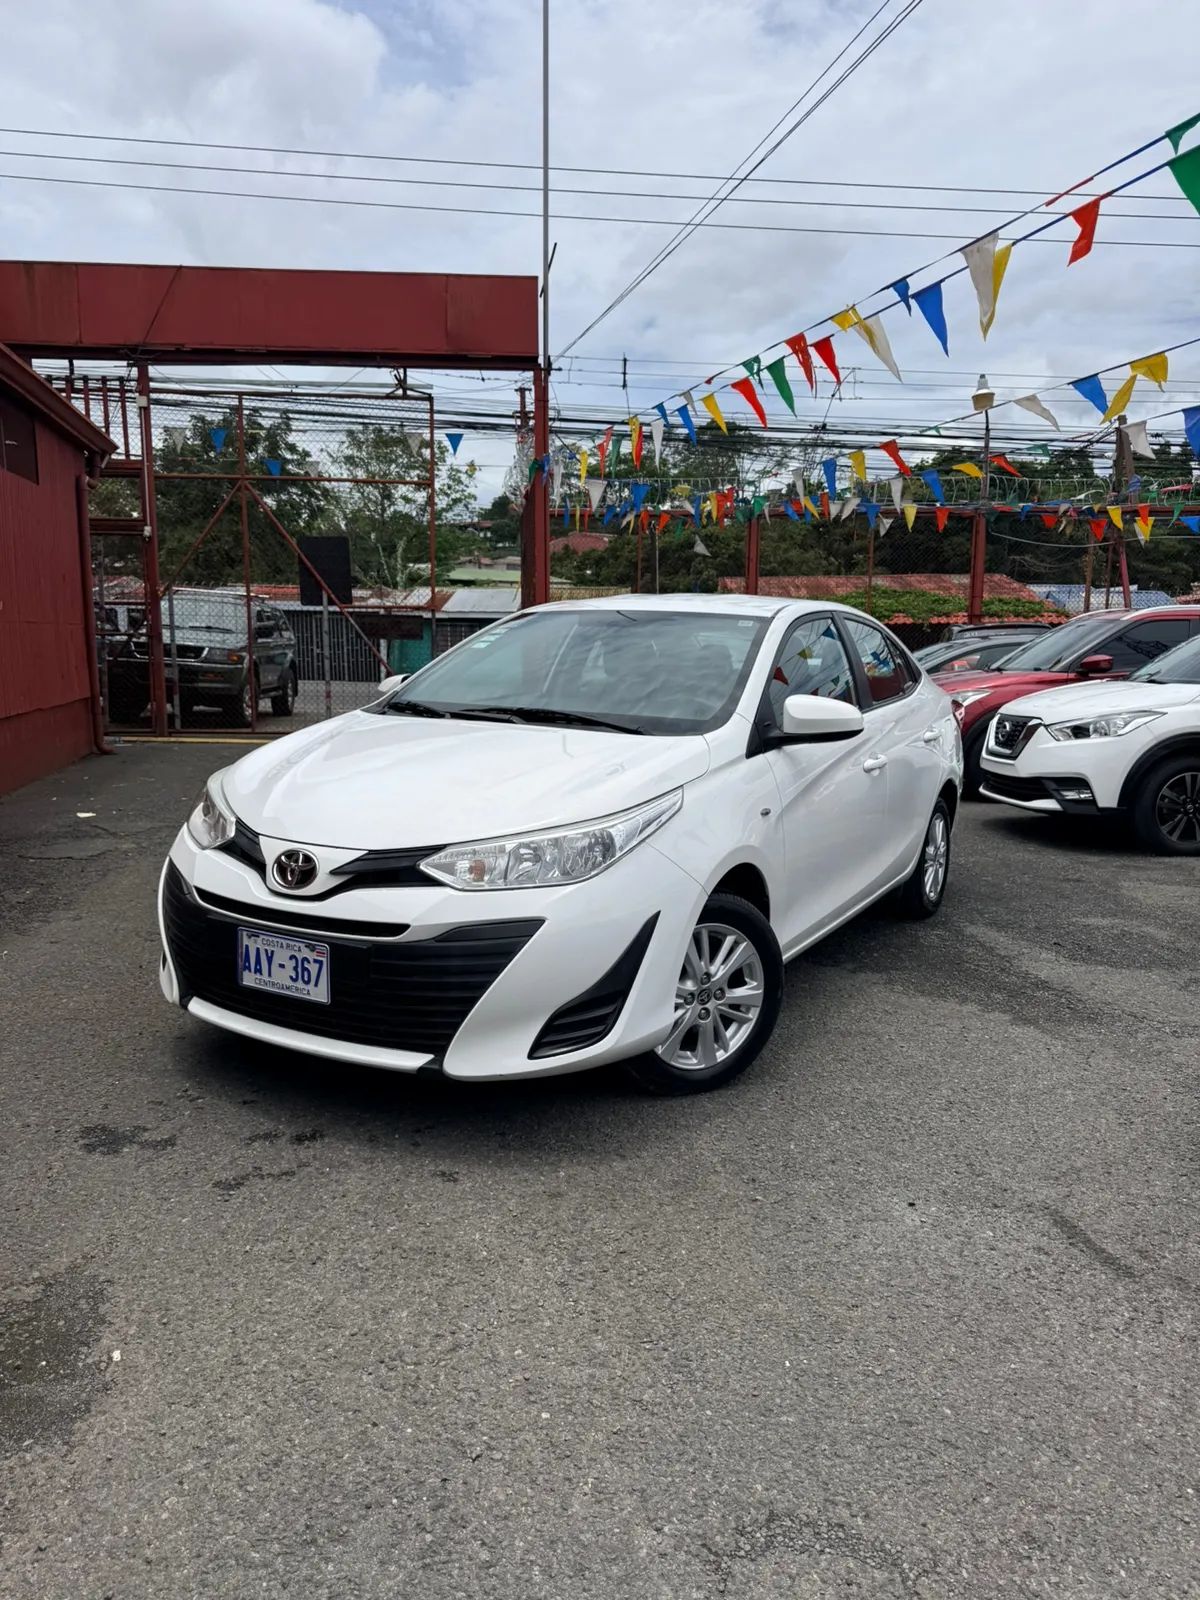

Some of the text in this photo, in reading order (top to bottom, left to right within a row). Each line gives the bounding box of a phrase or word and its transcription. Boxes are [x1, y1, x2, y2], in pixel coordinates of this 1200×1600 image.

[261, 937, 303, 953] COSTA RICA
[254, 977, 311, 996] CENTROAMERICA
